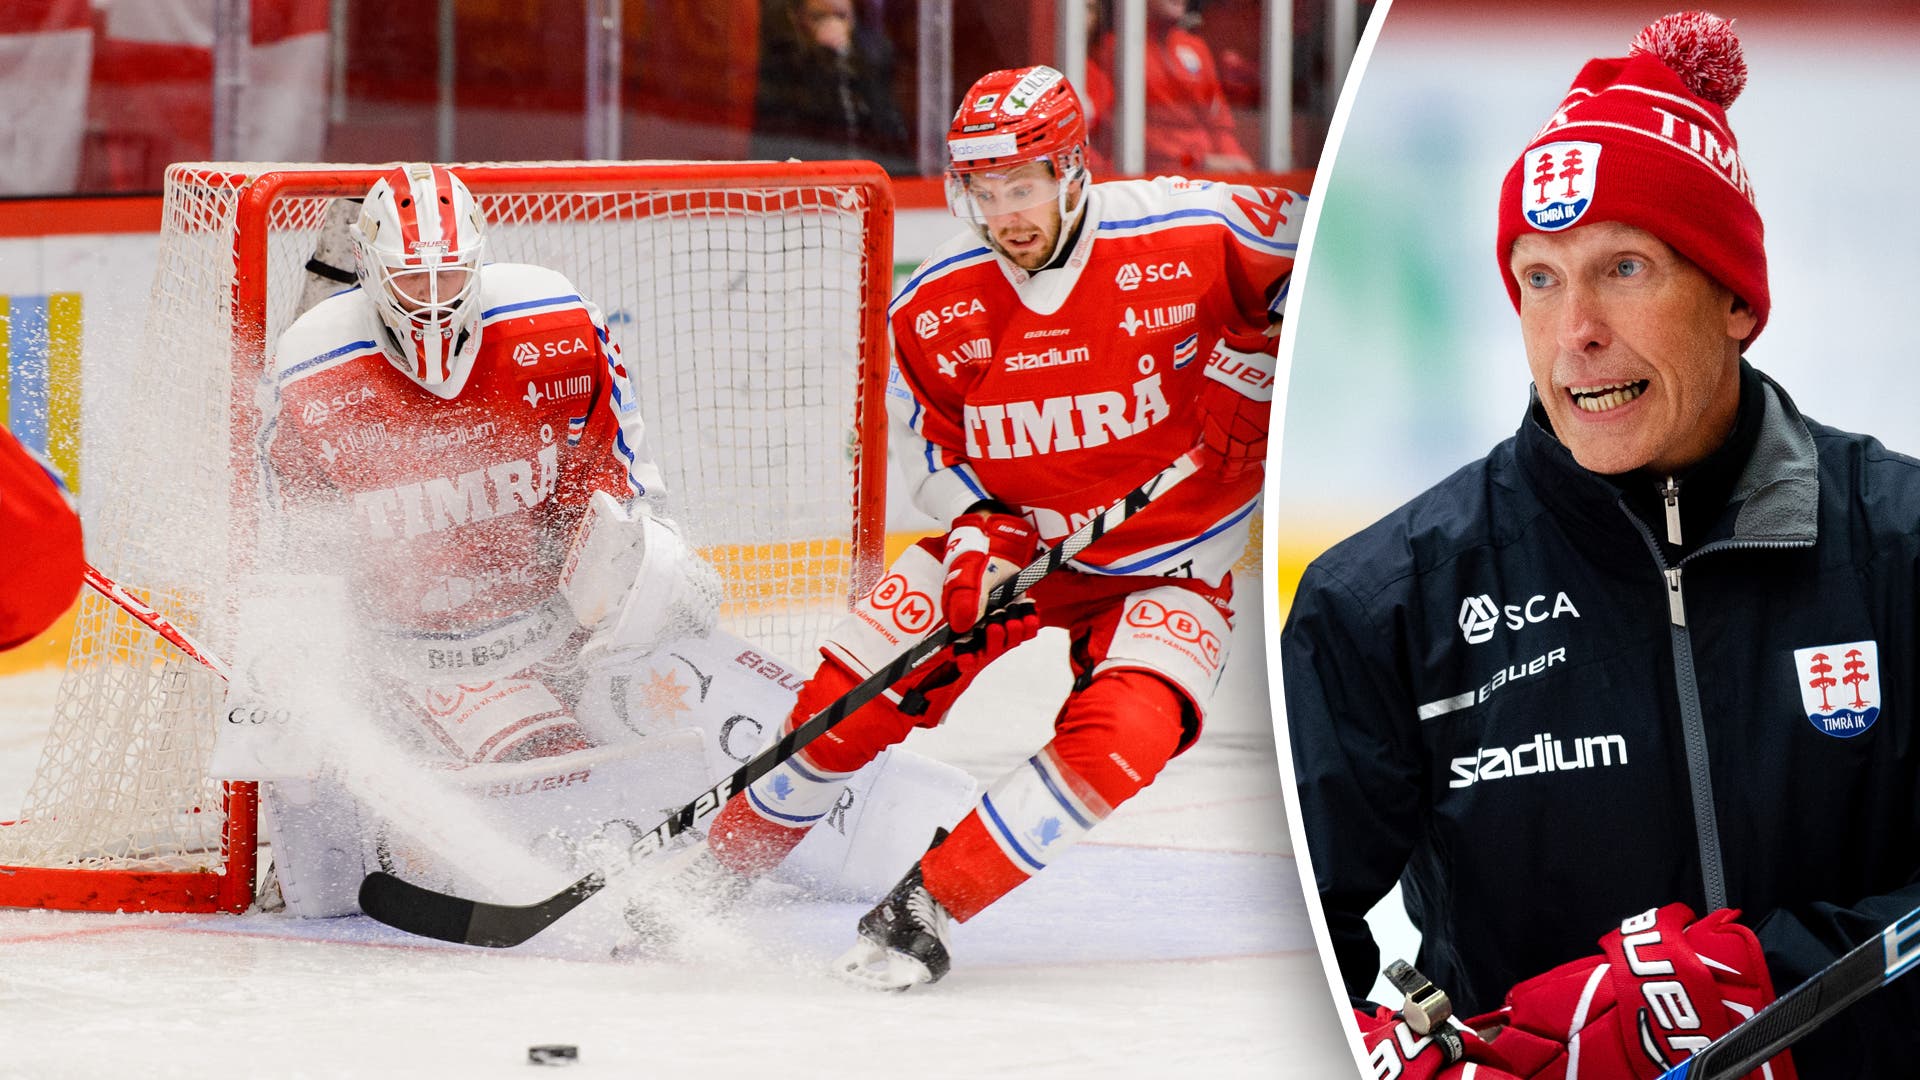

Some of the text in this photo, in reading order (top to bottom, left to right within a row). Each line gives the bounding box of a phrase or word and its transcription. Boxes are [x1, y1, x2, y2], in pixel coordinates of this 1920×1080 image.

[1536, 204, 1576, 224] TIMRÅ IK
[1146, 261, 1192, 282] SCA
[941, 298, 986, 323] SCA
[1144, 302, 1196, 329] LILIUM
[543, 337, 588, 358] SCA
[1005, 345, 1090, 372] stadium
[331, 386, 376, 413] SCA
[545, 375, 591, 400] LILIUM
[964, 354, 1170, 460] TIMRÅ
[354, 423, 559, 540] TIMRÅ
[1504, 591, 1580, 631] SCA
[1823, 713, 1866, 731] TIMRÅ IK
